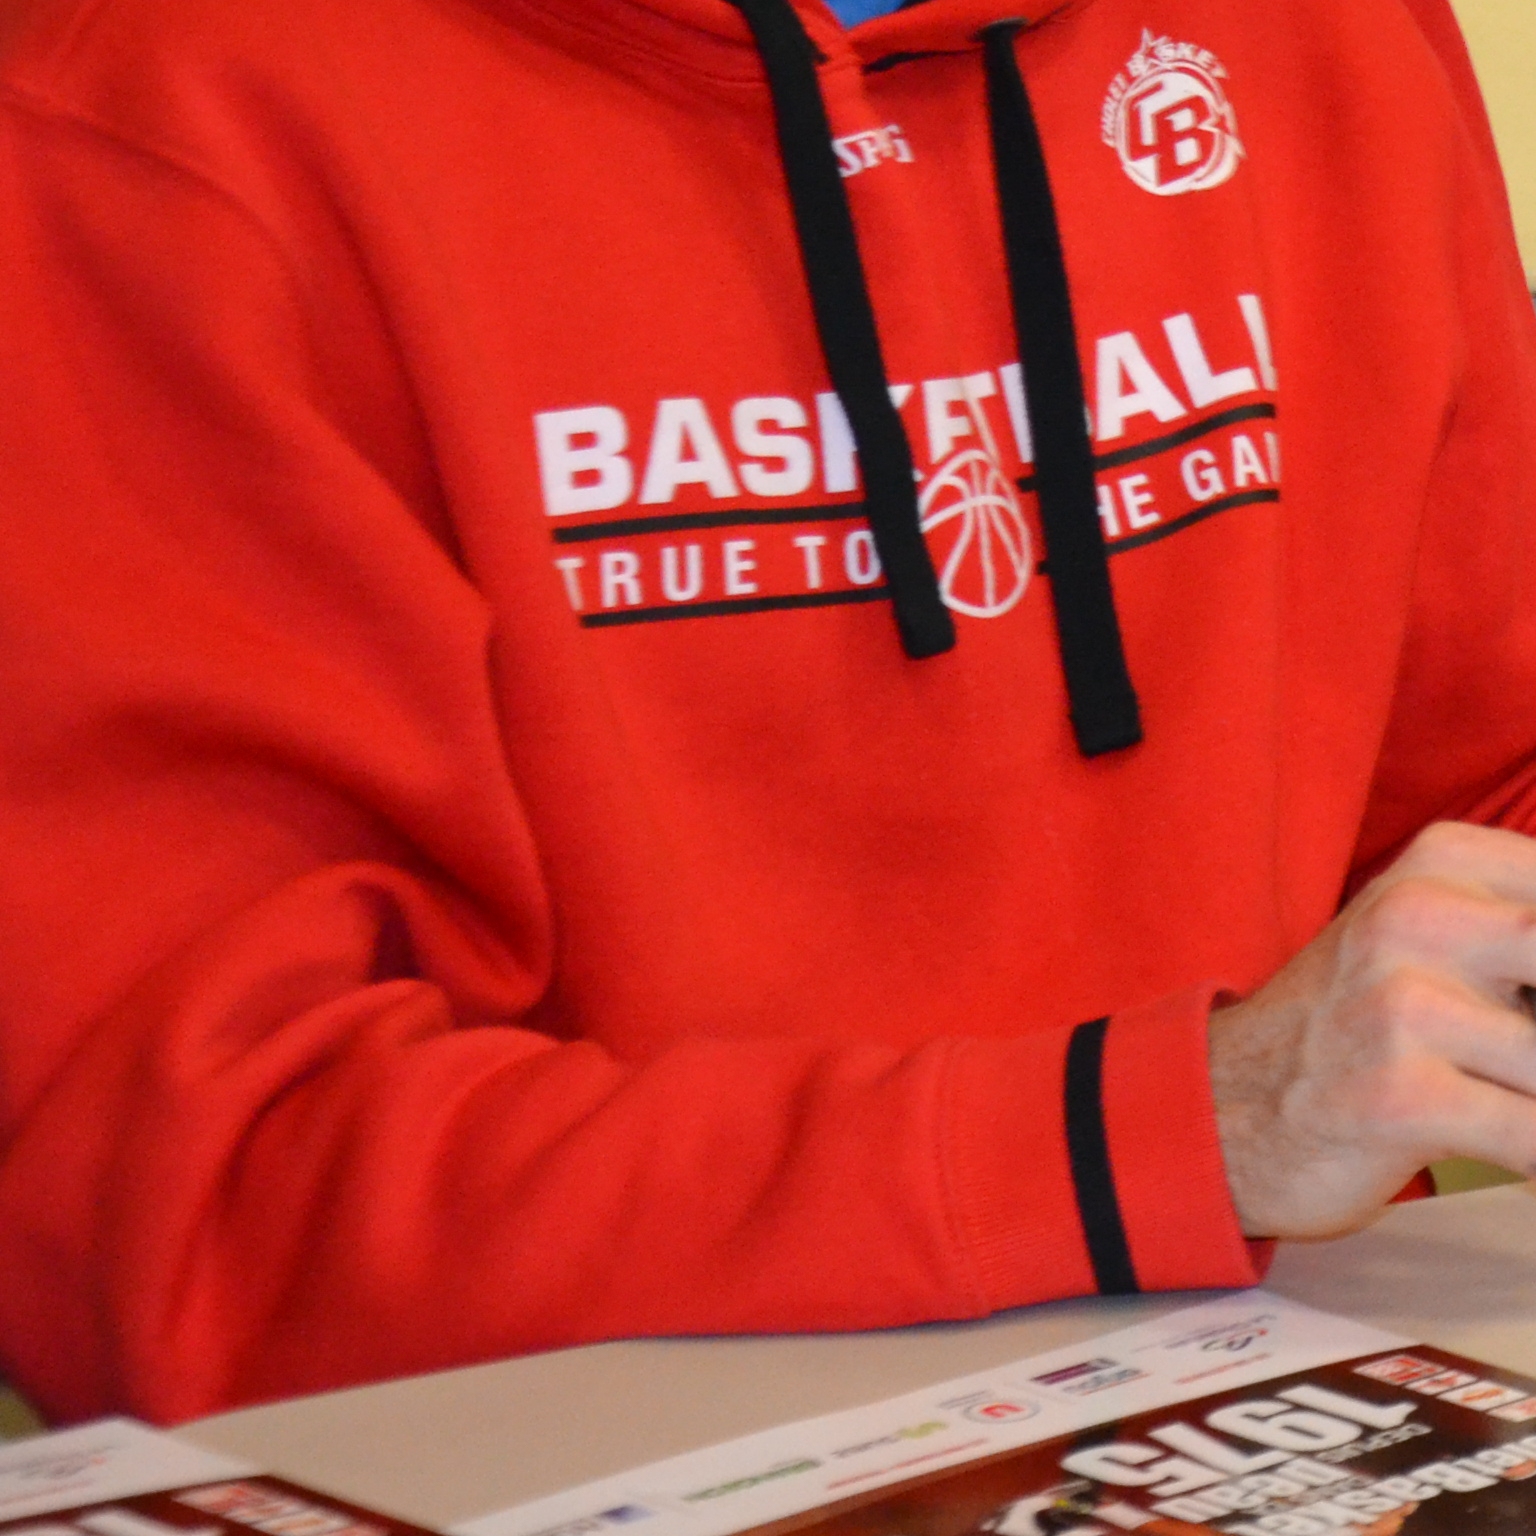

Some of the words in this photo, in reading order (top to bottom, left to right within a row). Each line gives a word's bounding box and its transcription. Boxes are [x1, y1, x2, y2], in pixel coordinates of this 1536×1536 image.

[533, 292, 1278, 517] BASKETALL
[554, 537, 759, 612] TRUE
[792, 529, 882, 591] TO
[1058, 1383, 1419, 1497] 1975
